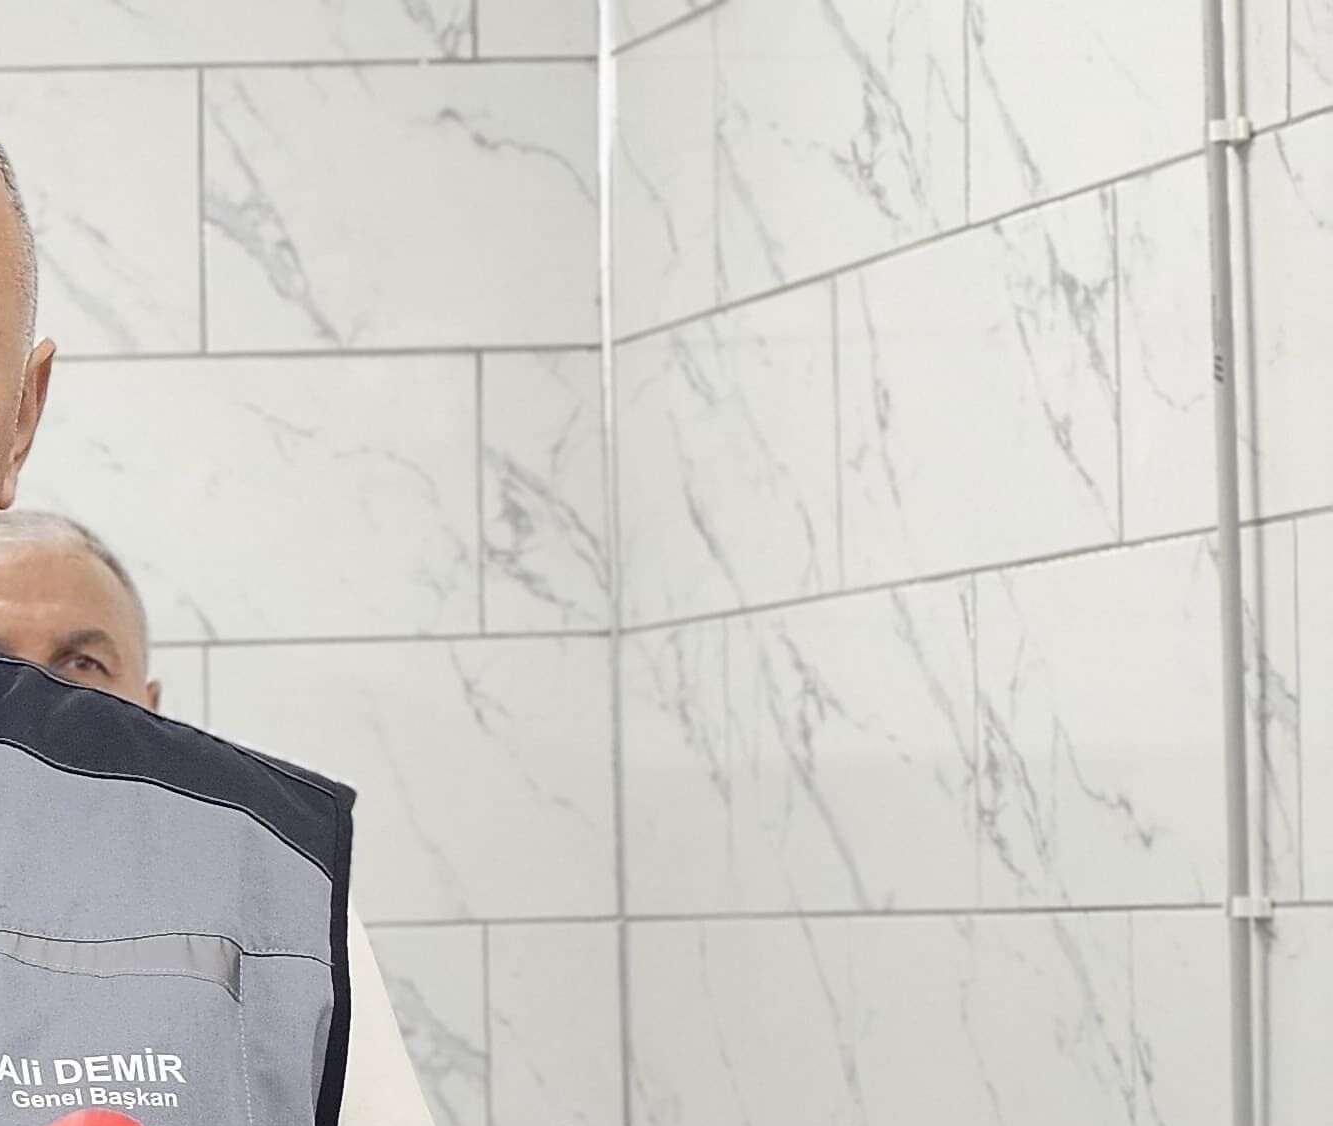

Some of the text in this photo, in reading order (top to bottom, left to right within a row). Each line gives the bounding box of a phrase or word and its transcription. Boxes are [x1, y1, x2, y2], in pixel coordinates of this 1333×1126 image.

[53, 1047, 187, 1085] DEMİR
[11, 1087, 179, 1109] Genel Başkan
